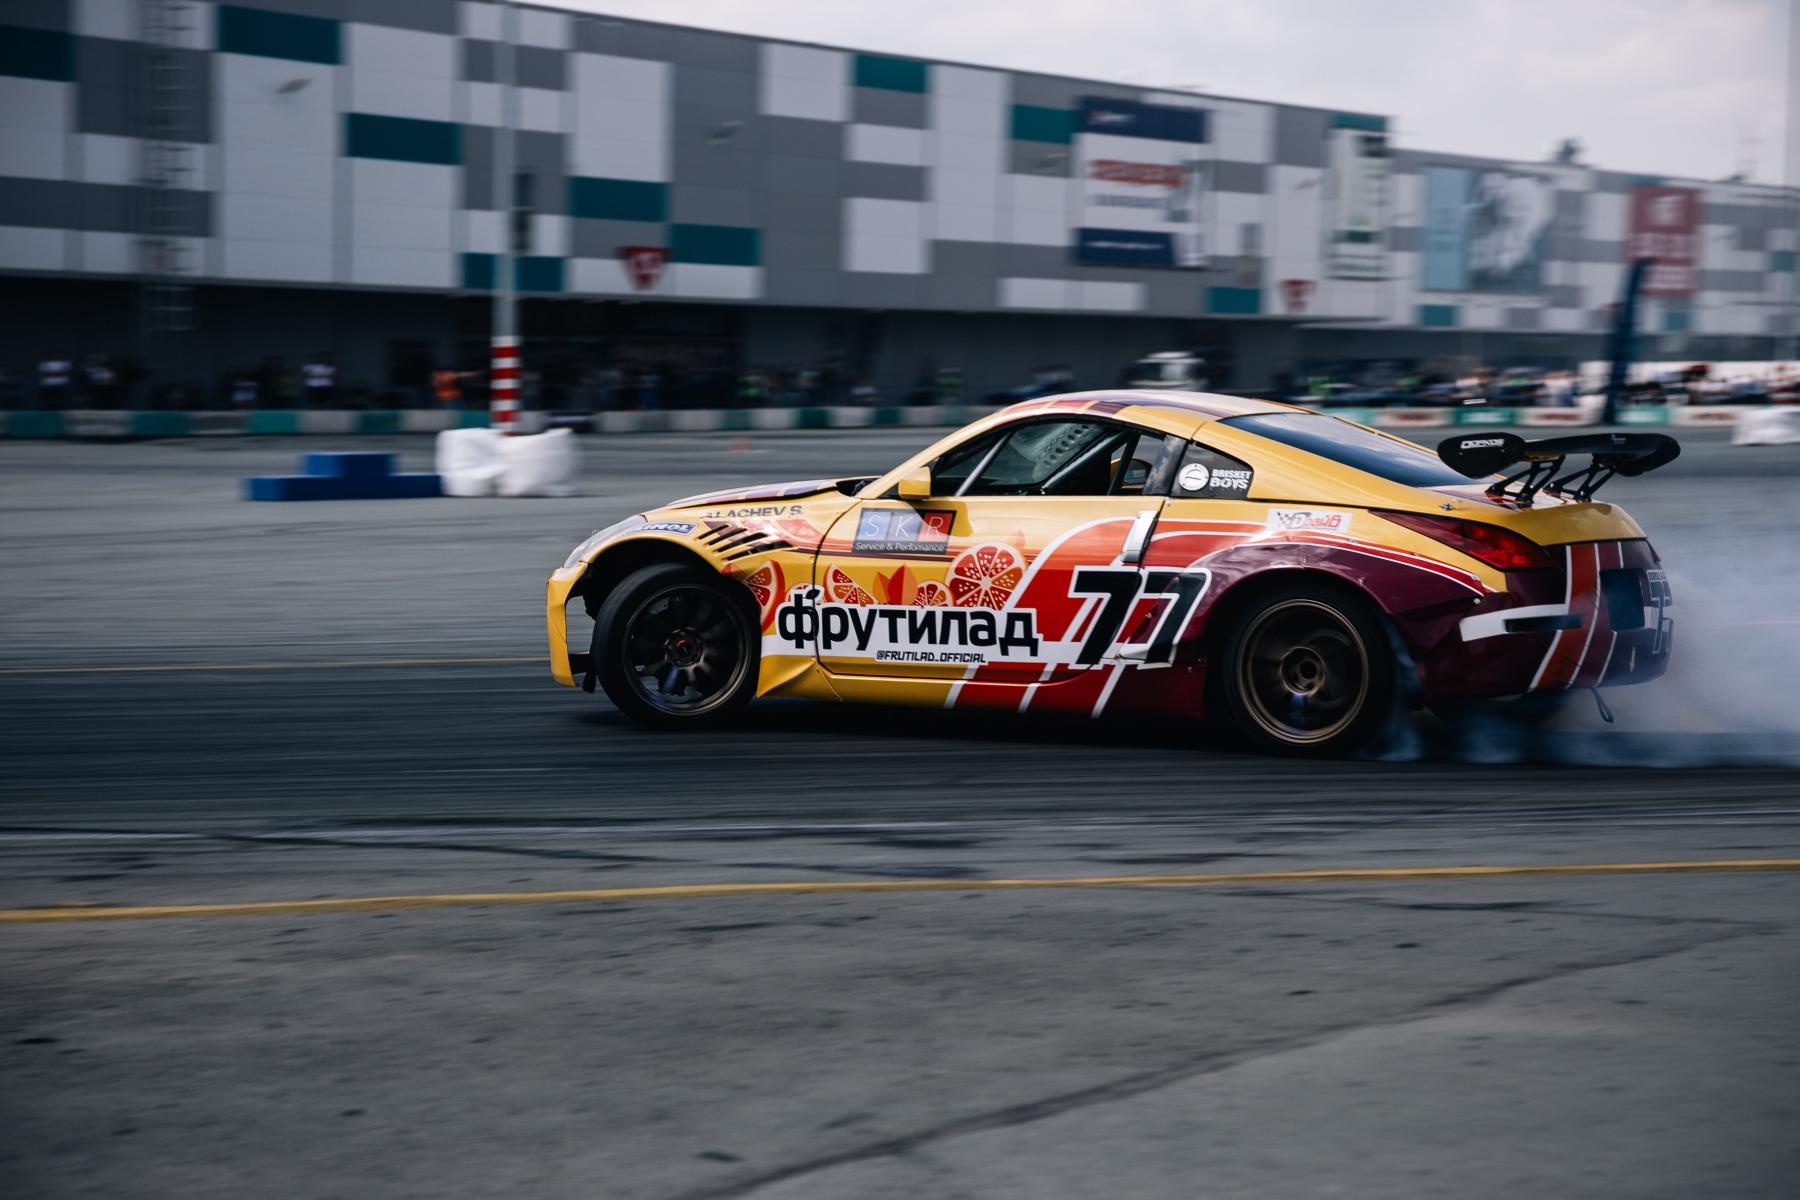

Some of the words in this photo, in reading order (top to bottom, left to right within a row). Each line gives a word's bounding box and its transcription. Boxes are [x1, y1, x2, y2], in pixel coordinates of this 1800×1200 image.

[1211, 469, 1253, 480] BRISKET
[1209, 478, 1249, 490] BOYS
[855, 541, 885, 551] Service
[886, 542, 893, 551] &
[1069, 567, 1211, 669] 77
